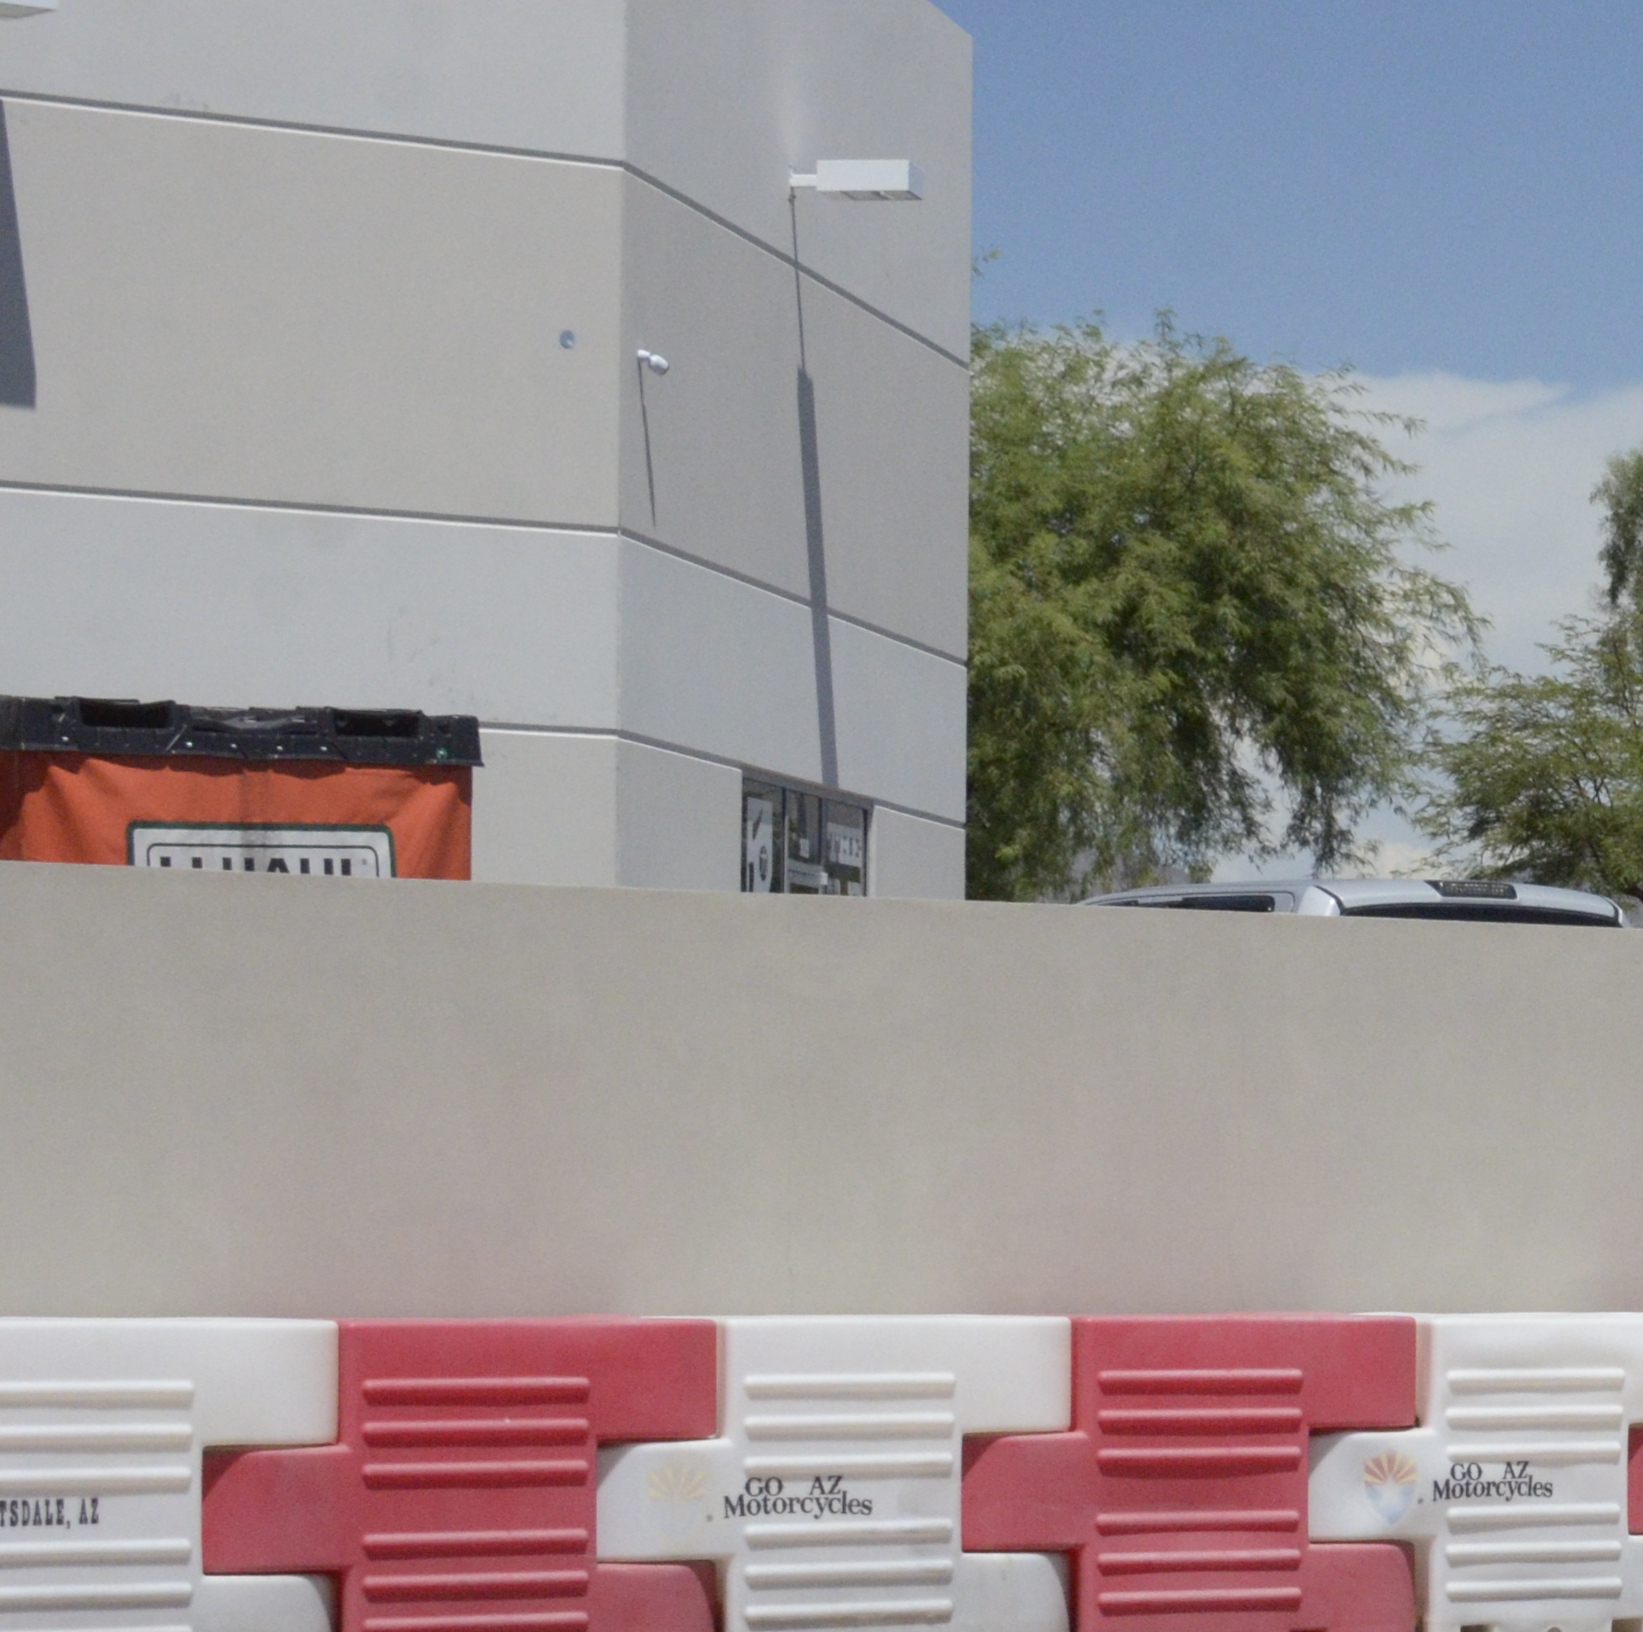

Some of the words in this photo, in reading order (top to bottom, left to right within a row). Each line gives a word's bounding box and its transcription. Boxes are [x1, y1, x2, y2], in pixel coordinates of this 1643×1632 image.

[1450, 1462, 1483, 1482] GO
[1502, 1461, 1530, 1480] AZ
[744, 1476, 784, 1497] GO
[808, 1475, 844, 1496] AZ
[1432, 1475, 1554, 1502] Motorcycles
[79, 1497, 99, 1525] AZ
[723, 1490, 873, 1519] Motorcycles
